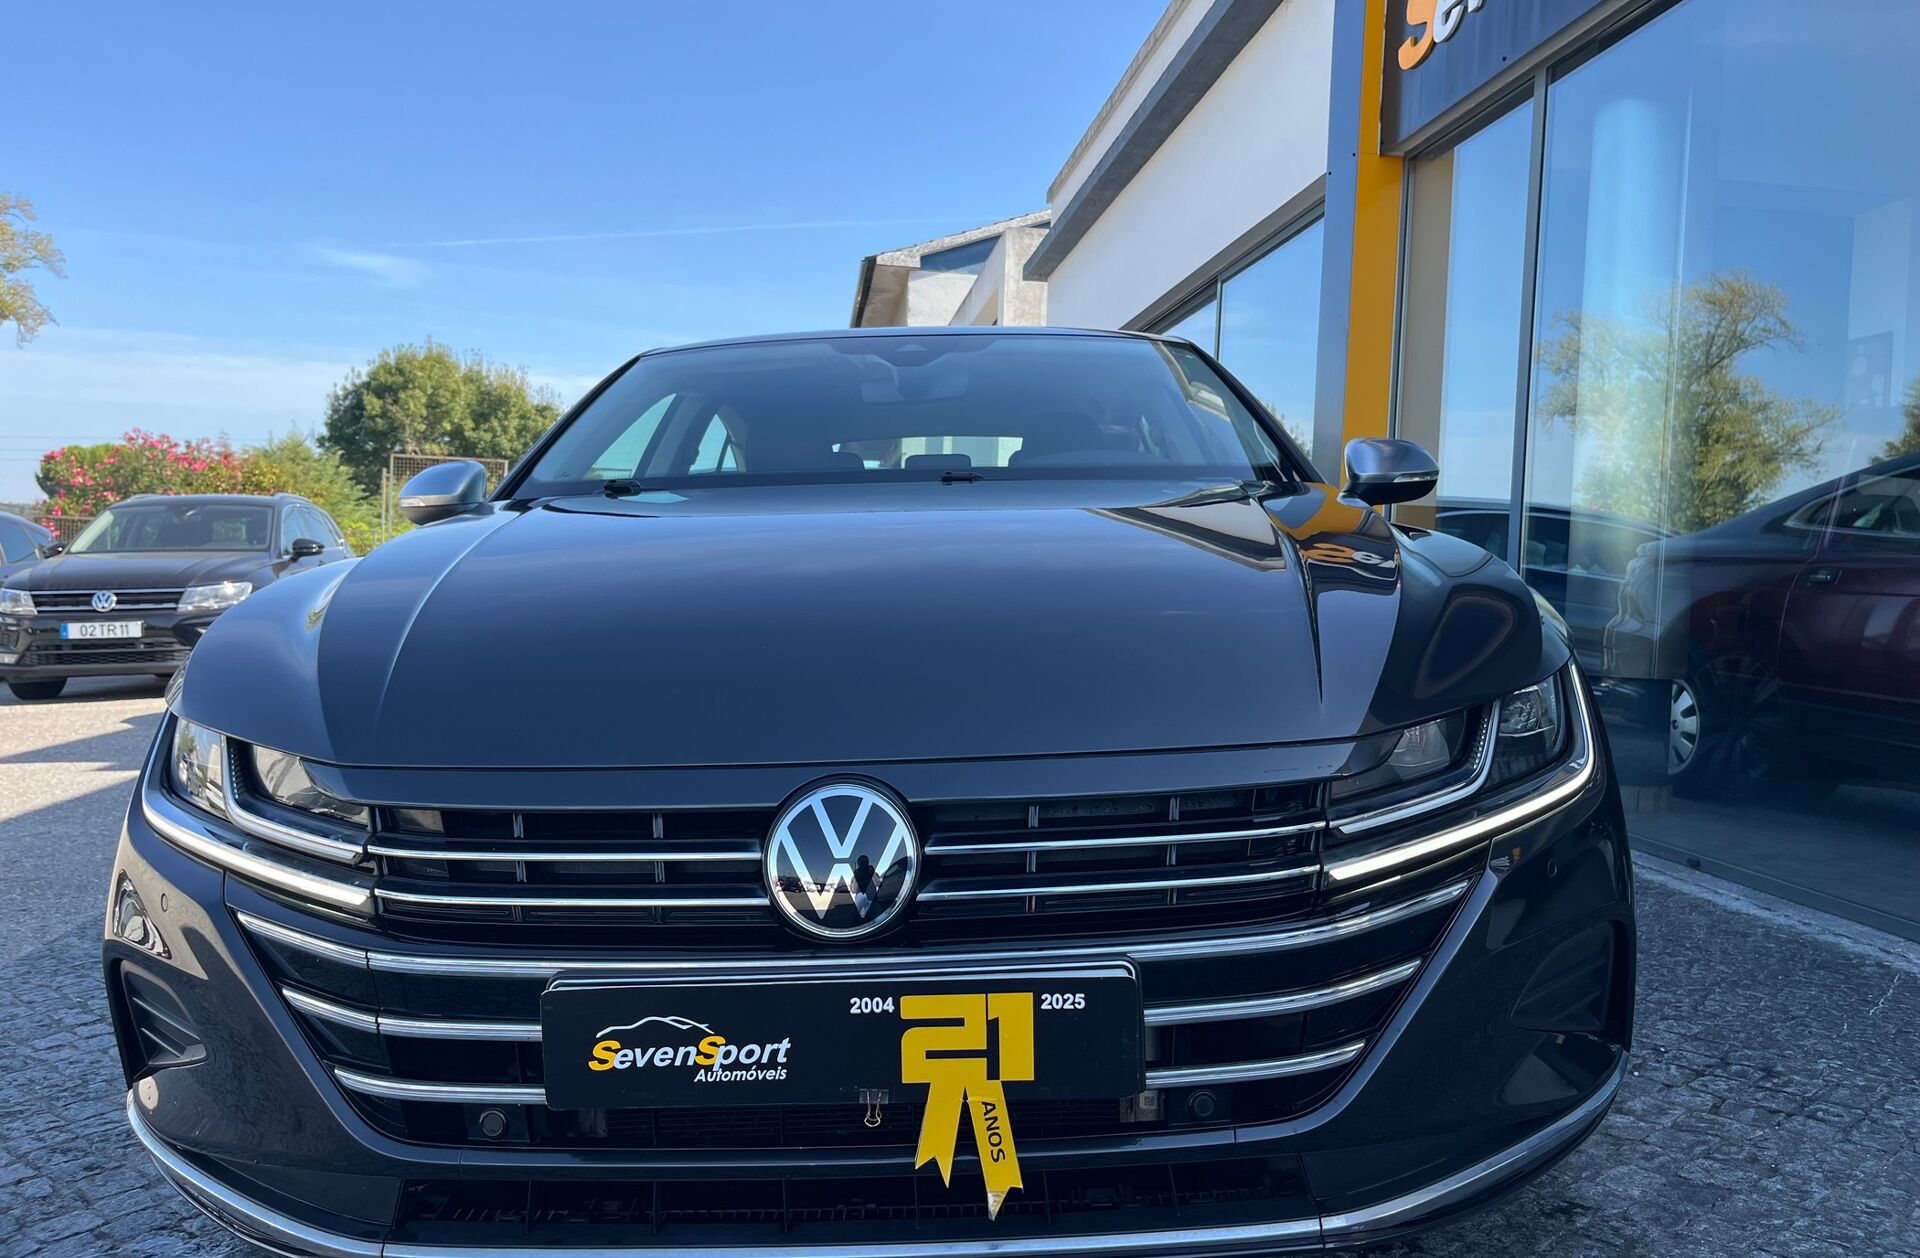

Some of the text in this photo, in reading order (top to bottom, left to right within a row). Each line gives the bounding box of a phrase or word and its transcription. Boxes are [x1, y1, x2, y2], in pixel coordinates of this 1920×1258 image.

[1398, 0, 1486, 70] Se
[771, 785, 914, 933] VW
[588, 1035, 791, 1072] SevenSport
[849, 992, 1086, 1084] 2004 21 2025
[694, 1065, 787, 1082] Automóveis
[981, 1100, 1006, 1163] ANOS
